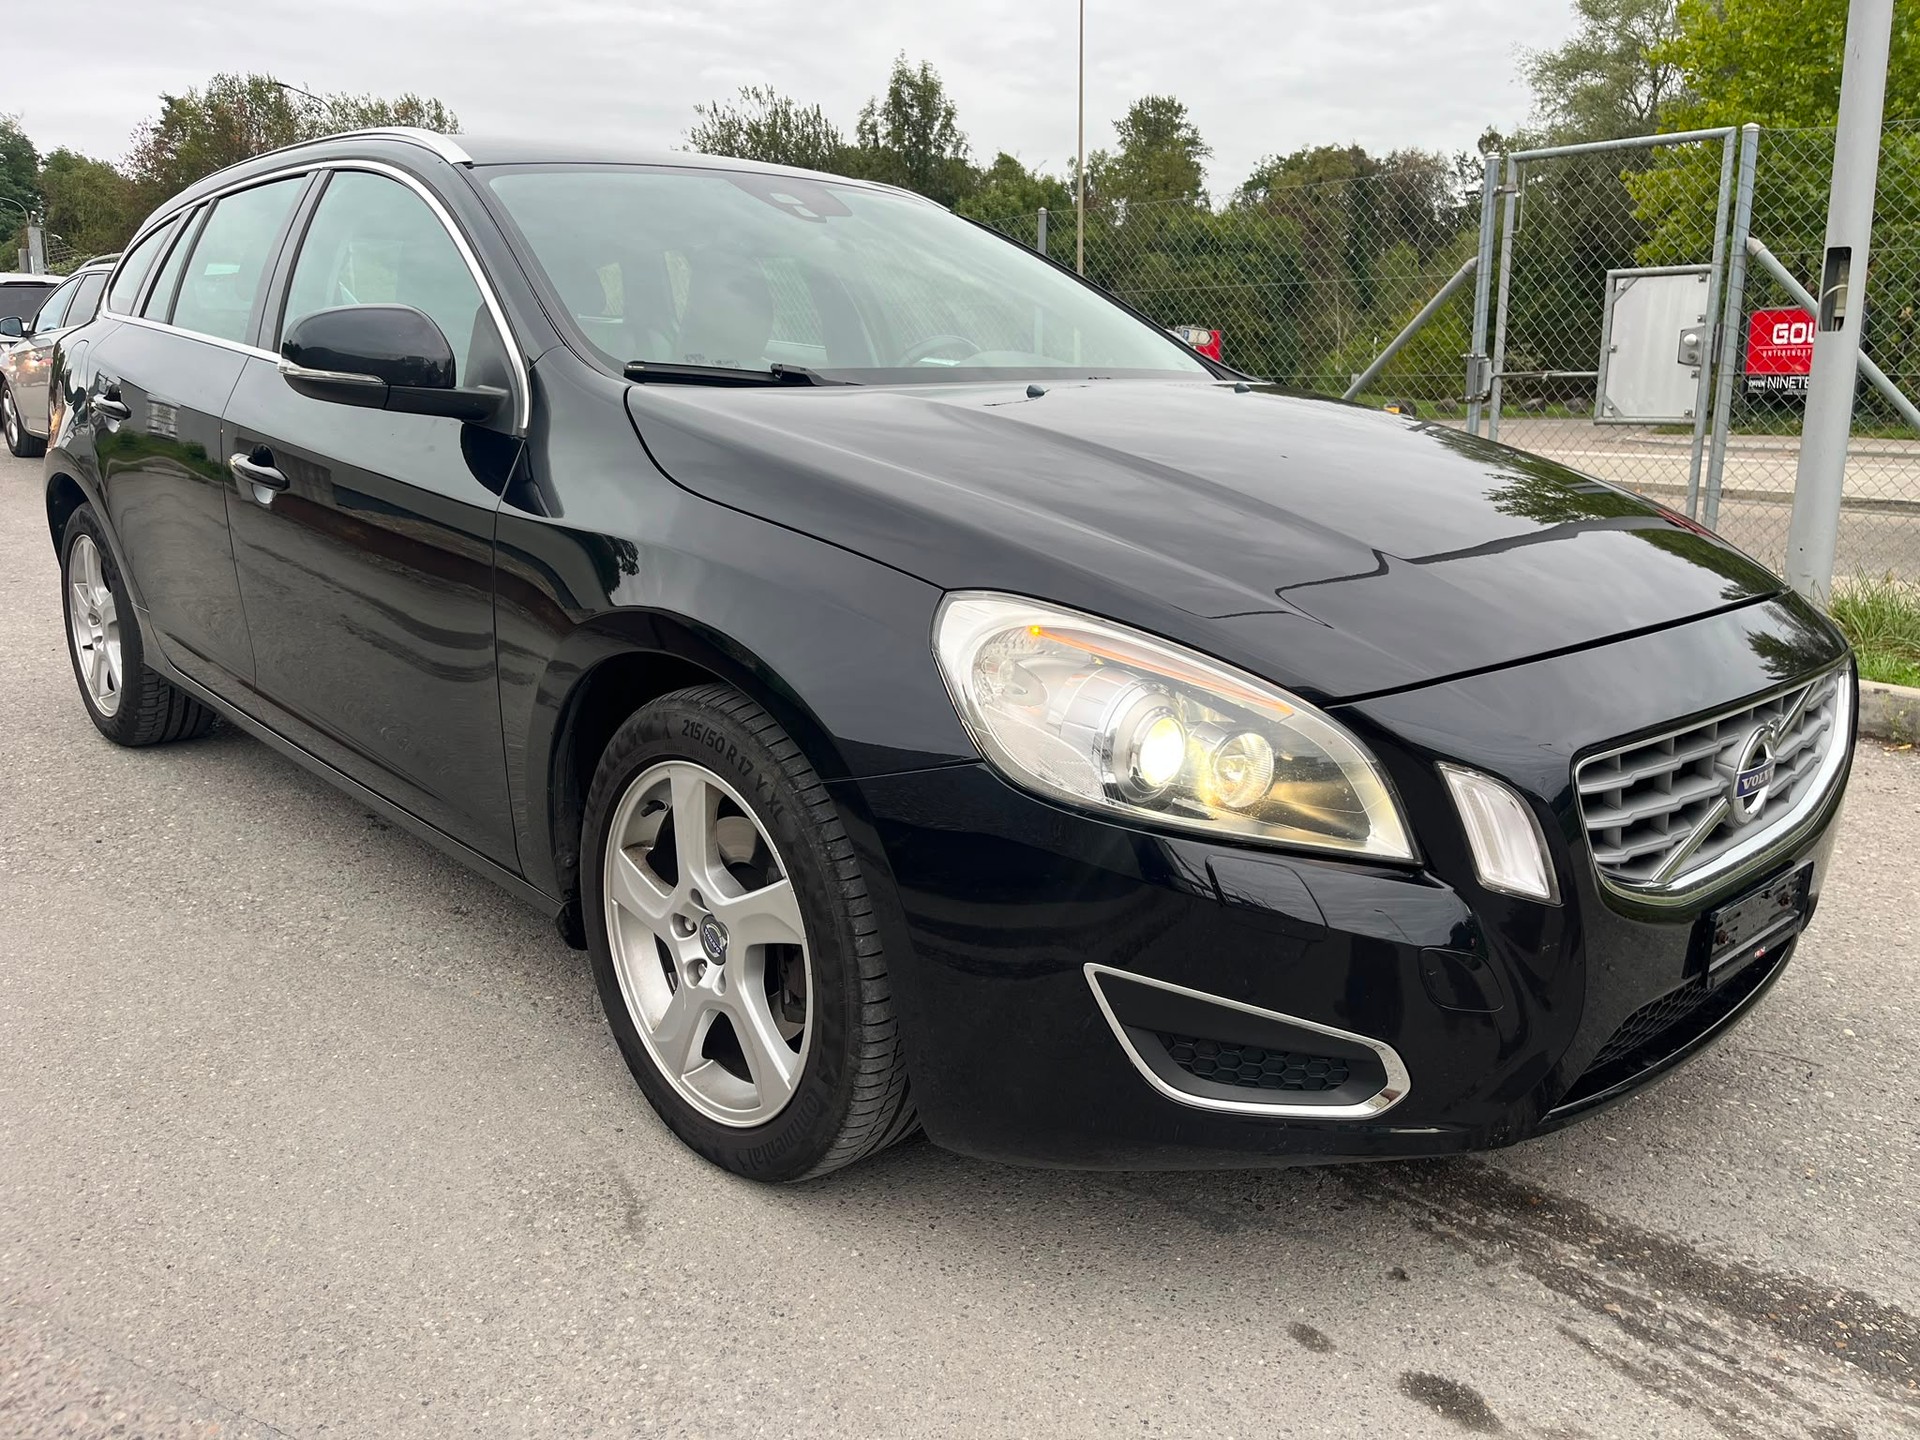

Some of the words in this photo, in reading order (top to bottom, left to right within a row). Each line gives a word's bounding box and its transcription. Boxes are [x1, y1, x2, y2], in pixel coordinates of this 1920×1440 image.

[681, 719, 726, 754] 215/50
[725, 743, 738, 766] R
[737, 756, 755, 777] 17
